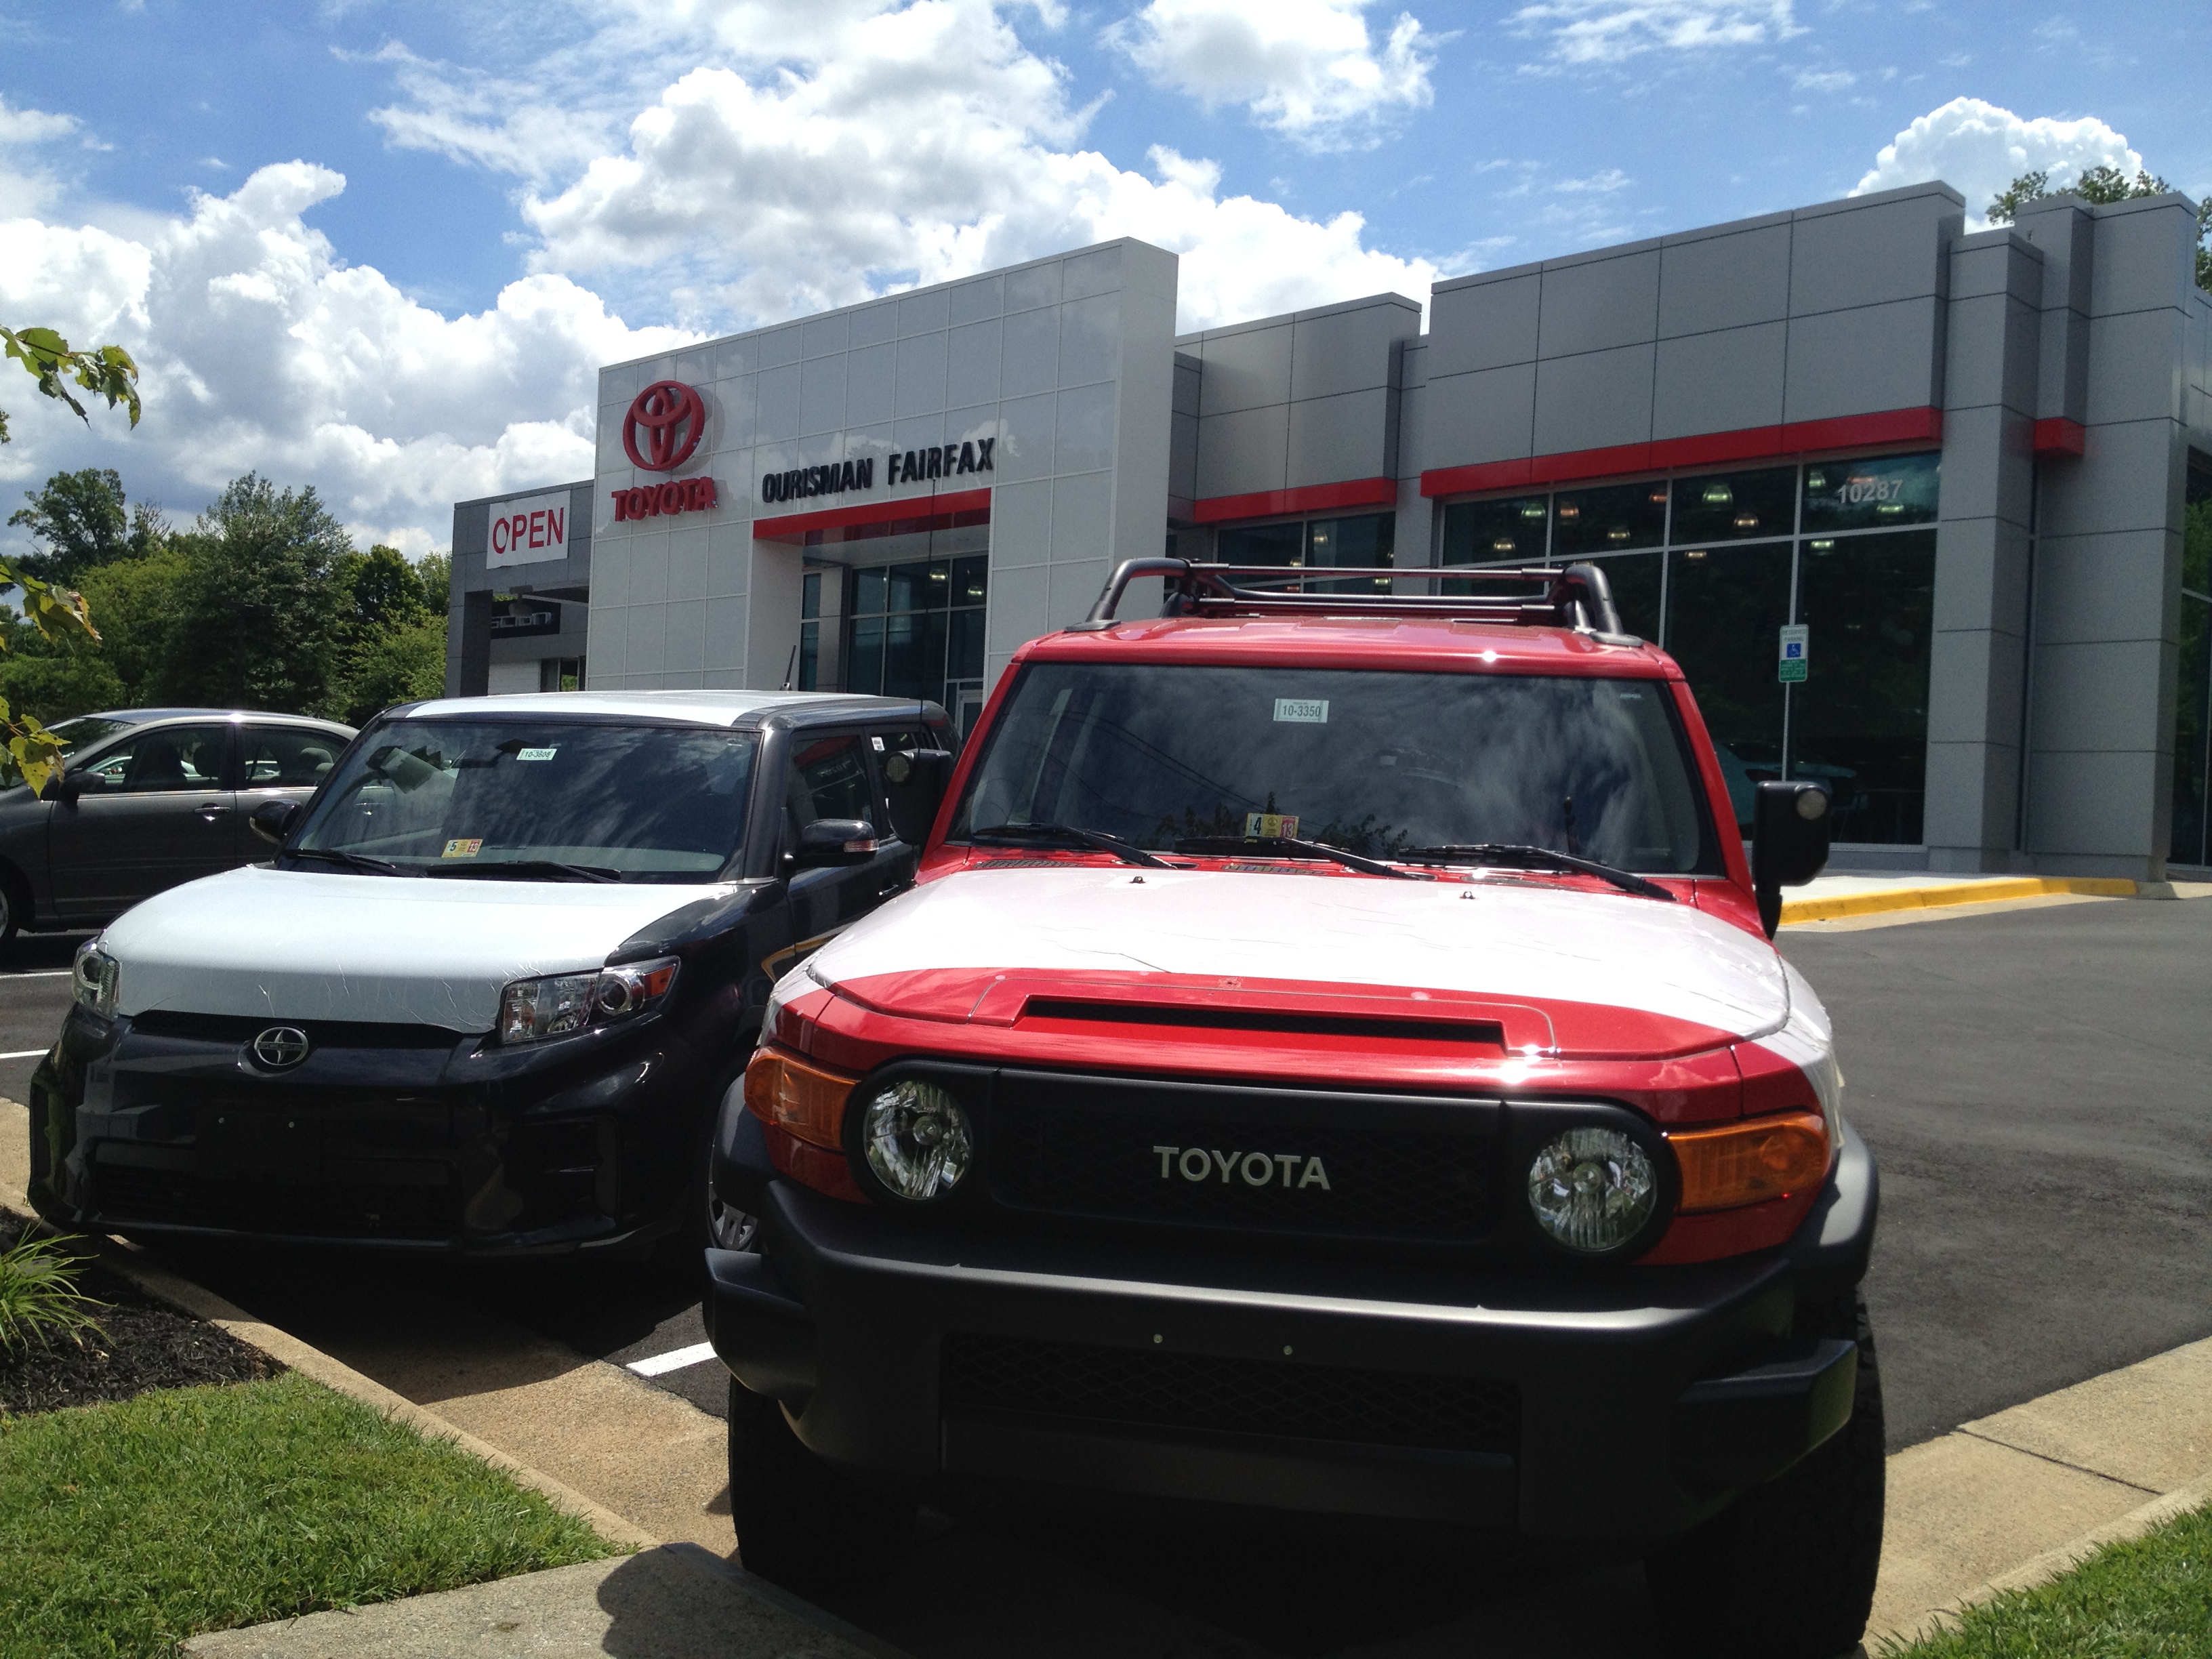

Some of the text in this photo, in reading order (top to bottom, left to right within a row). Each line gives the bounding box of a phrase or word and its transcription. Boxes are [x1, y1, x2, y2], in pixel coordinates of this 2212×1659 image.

[762, 438, 994, 503] OURISMAN FAIRFAX
[611, 476, 718, 521] TOYOTA
[1837, 479, 1903, 504] 10287
[493, 507, 564, 554] OPEN
[1283, 705, 1321, 717] 10-3350
[1254, 817, 1262, 834] 4
[1282, 822, 1294, 838] 13
[450, 841, 458, 852] 5
[469, 842, 479, 852] 13
[1153, 1145, 1331, 1190] TOYOTA
